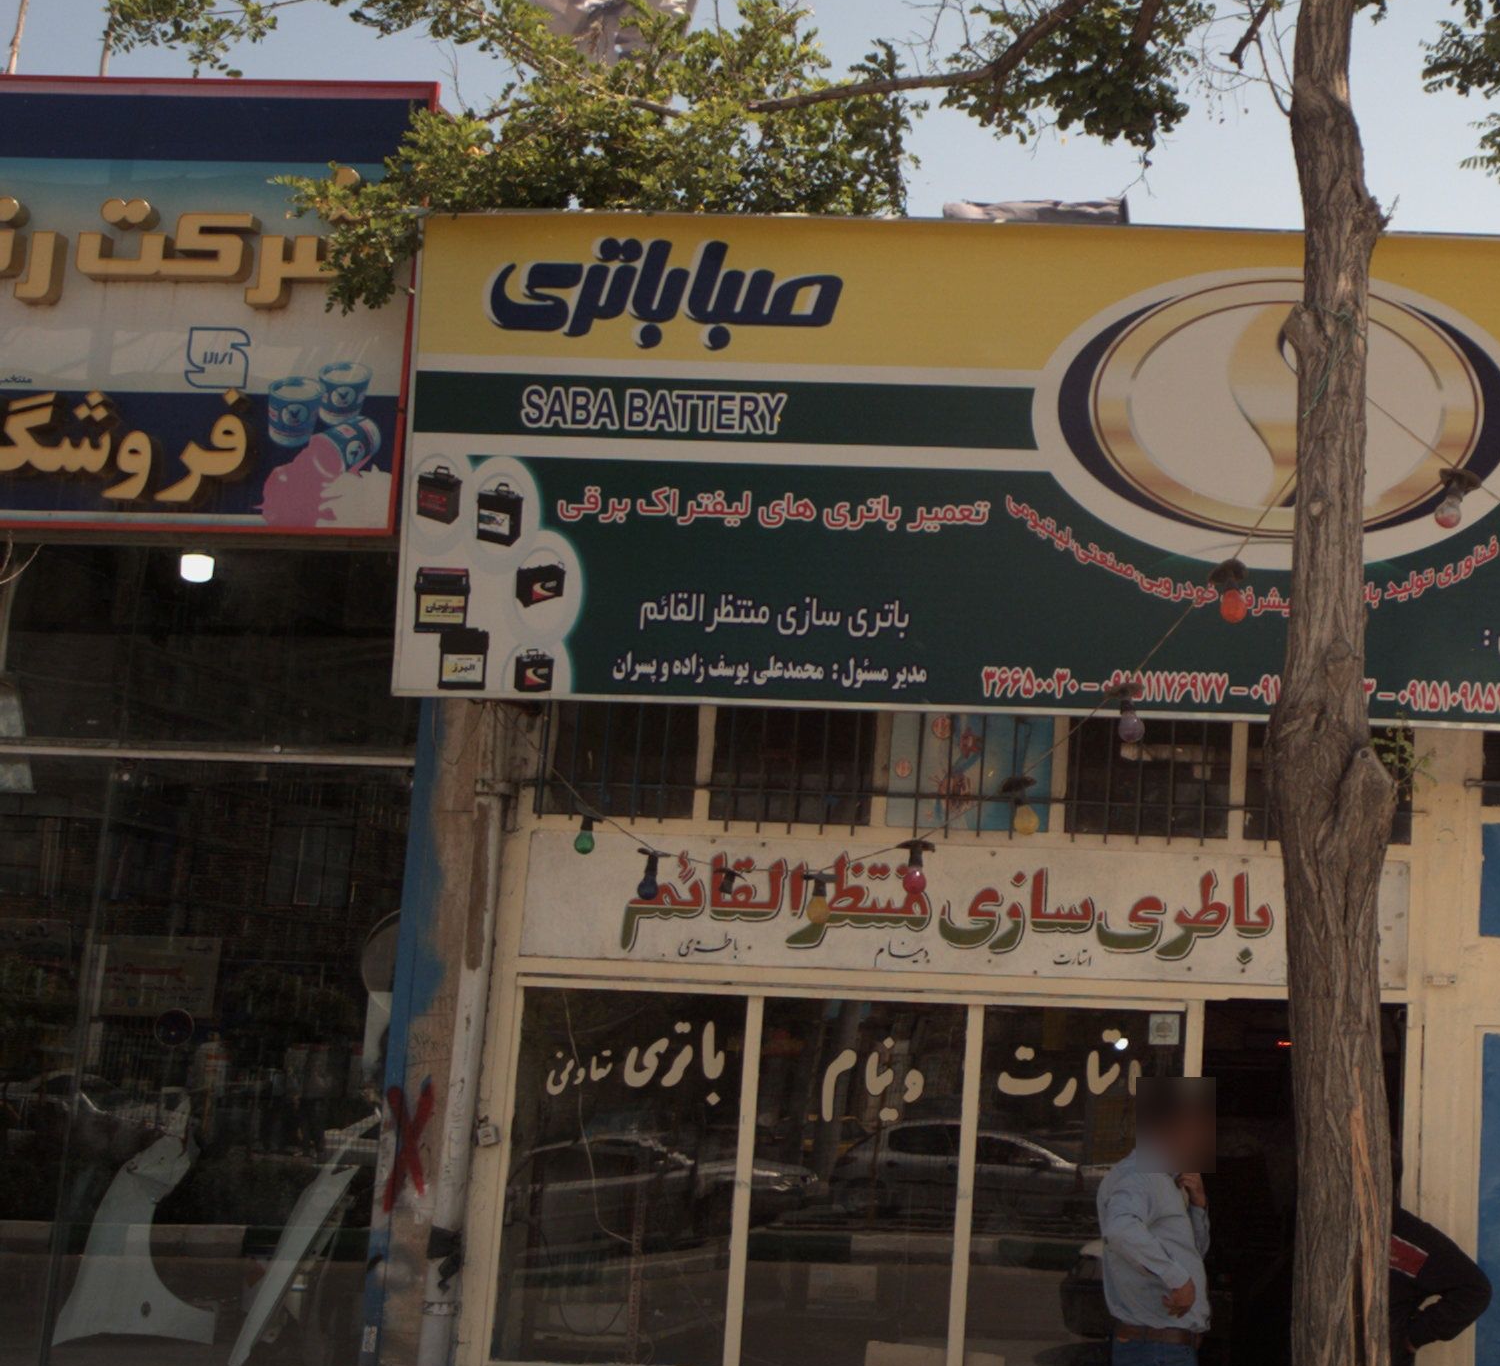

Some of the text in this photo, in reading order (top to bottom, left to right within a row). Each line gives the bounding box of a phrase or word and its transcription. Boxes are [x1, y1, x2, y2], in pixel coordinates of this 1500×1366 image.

[521, 385, 787, 434] SABA BATTERY
[0, 388, 247, 501] فروشگ
[557, 486, 990, 533] تعمیر باتری های لیفتراک برقی
[1006, 494, 1073, 551] لیتیومی
[1436, 534, 1499, 587] فناوری
[1384, 567, 1435, 604] تولید
[639, 591, 911, 639] باتری سازی منتظر القائم
[612, 650, 658, 683] پسران
[660, 662, 669, 684] و
[672, 650, 705, 683] زاده
[708, 652, 749, 685] یوسف
[891, 661, 928, 690] مدیر
[939, 866, 1094, 954] سازی
[1096, 869, 1273, 964] باطری
[624, 1021, 725, 1106] باتری
